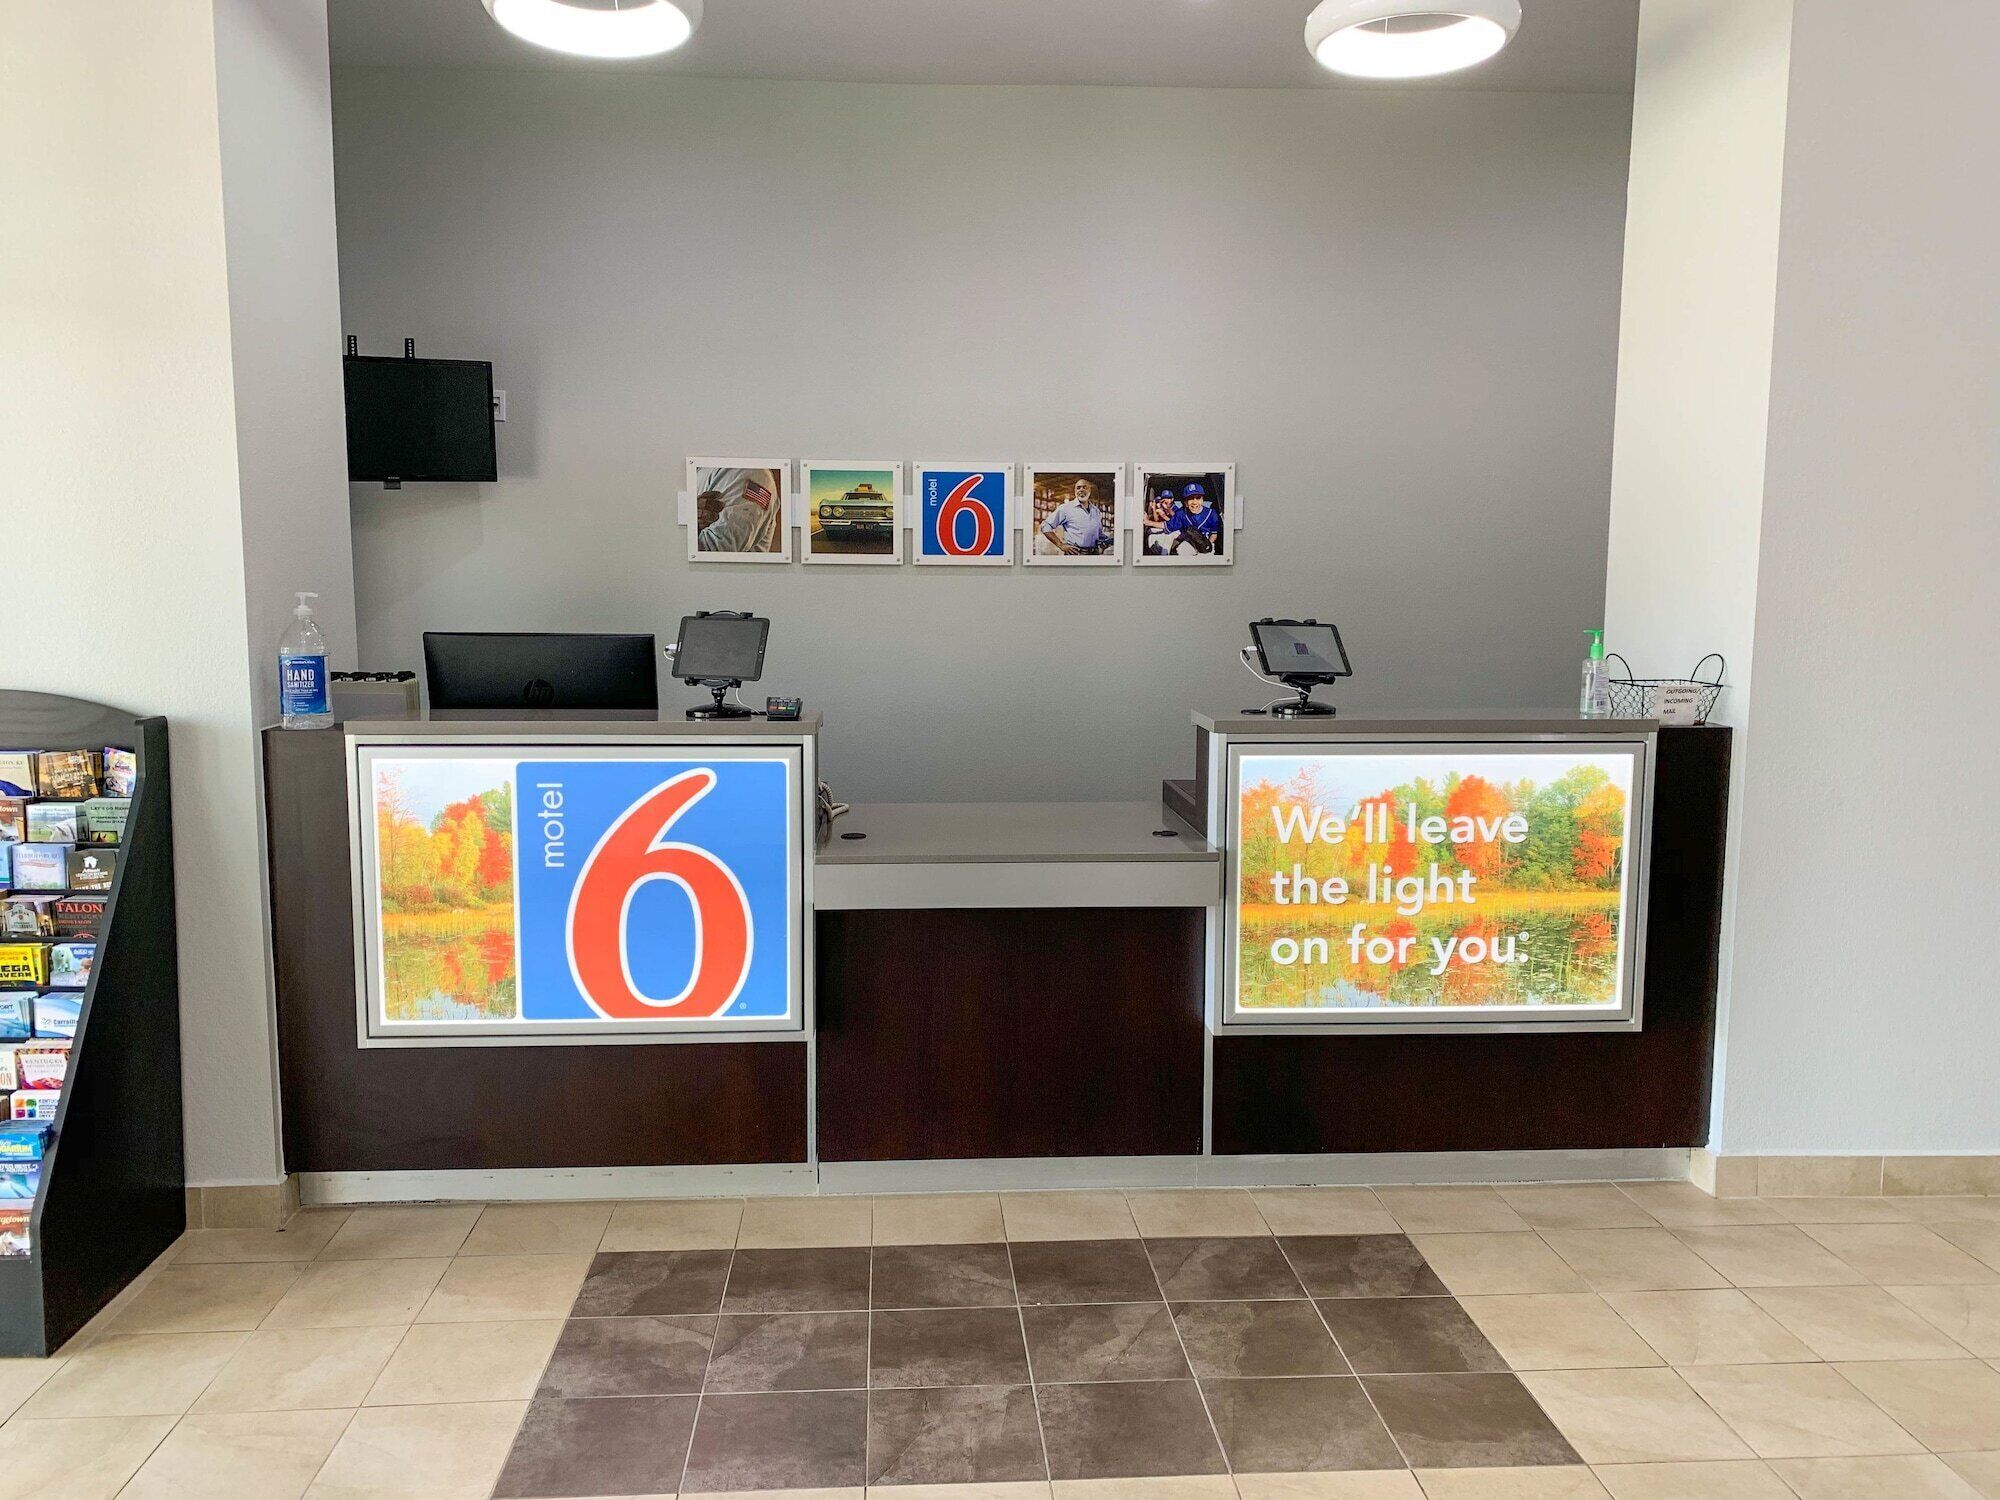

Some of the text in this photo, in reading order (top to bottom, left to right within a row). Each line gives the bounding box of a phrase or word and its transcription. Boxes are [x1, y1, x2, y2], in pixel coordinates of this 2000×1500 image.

[928, 479, 938, 507] motel
[936, 473, 995, 556] 6
[286, 669, 315, 681] HAND
[537, 782, 565, 868] motel
[1271, 802, 1529, 844] We'll leave
[56, 902, 103, 913] TALON
[565, 767, 754, 1019] 6
[1270, 864, 1477, 916] the light
[1270, 937, 1329, 965] on
[1347, 924, 1415, 965] for
